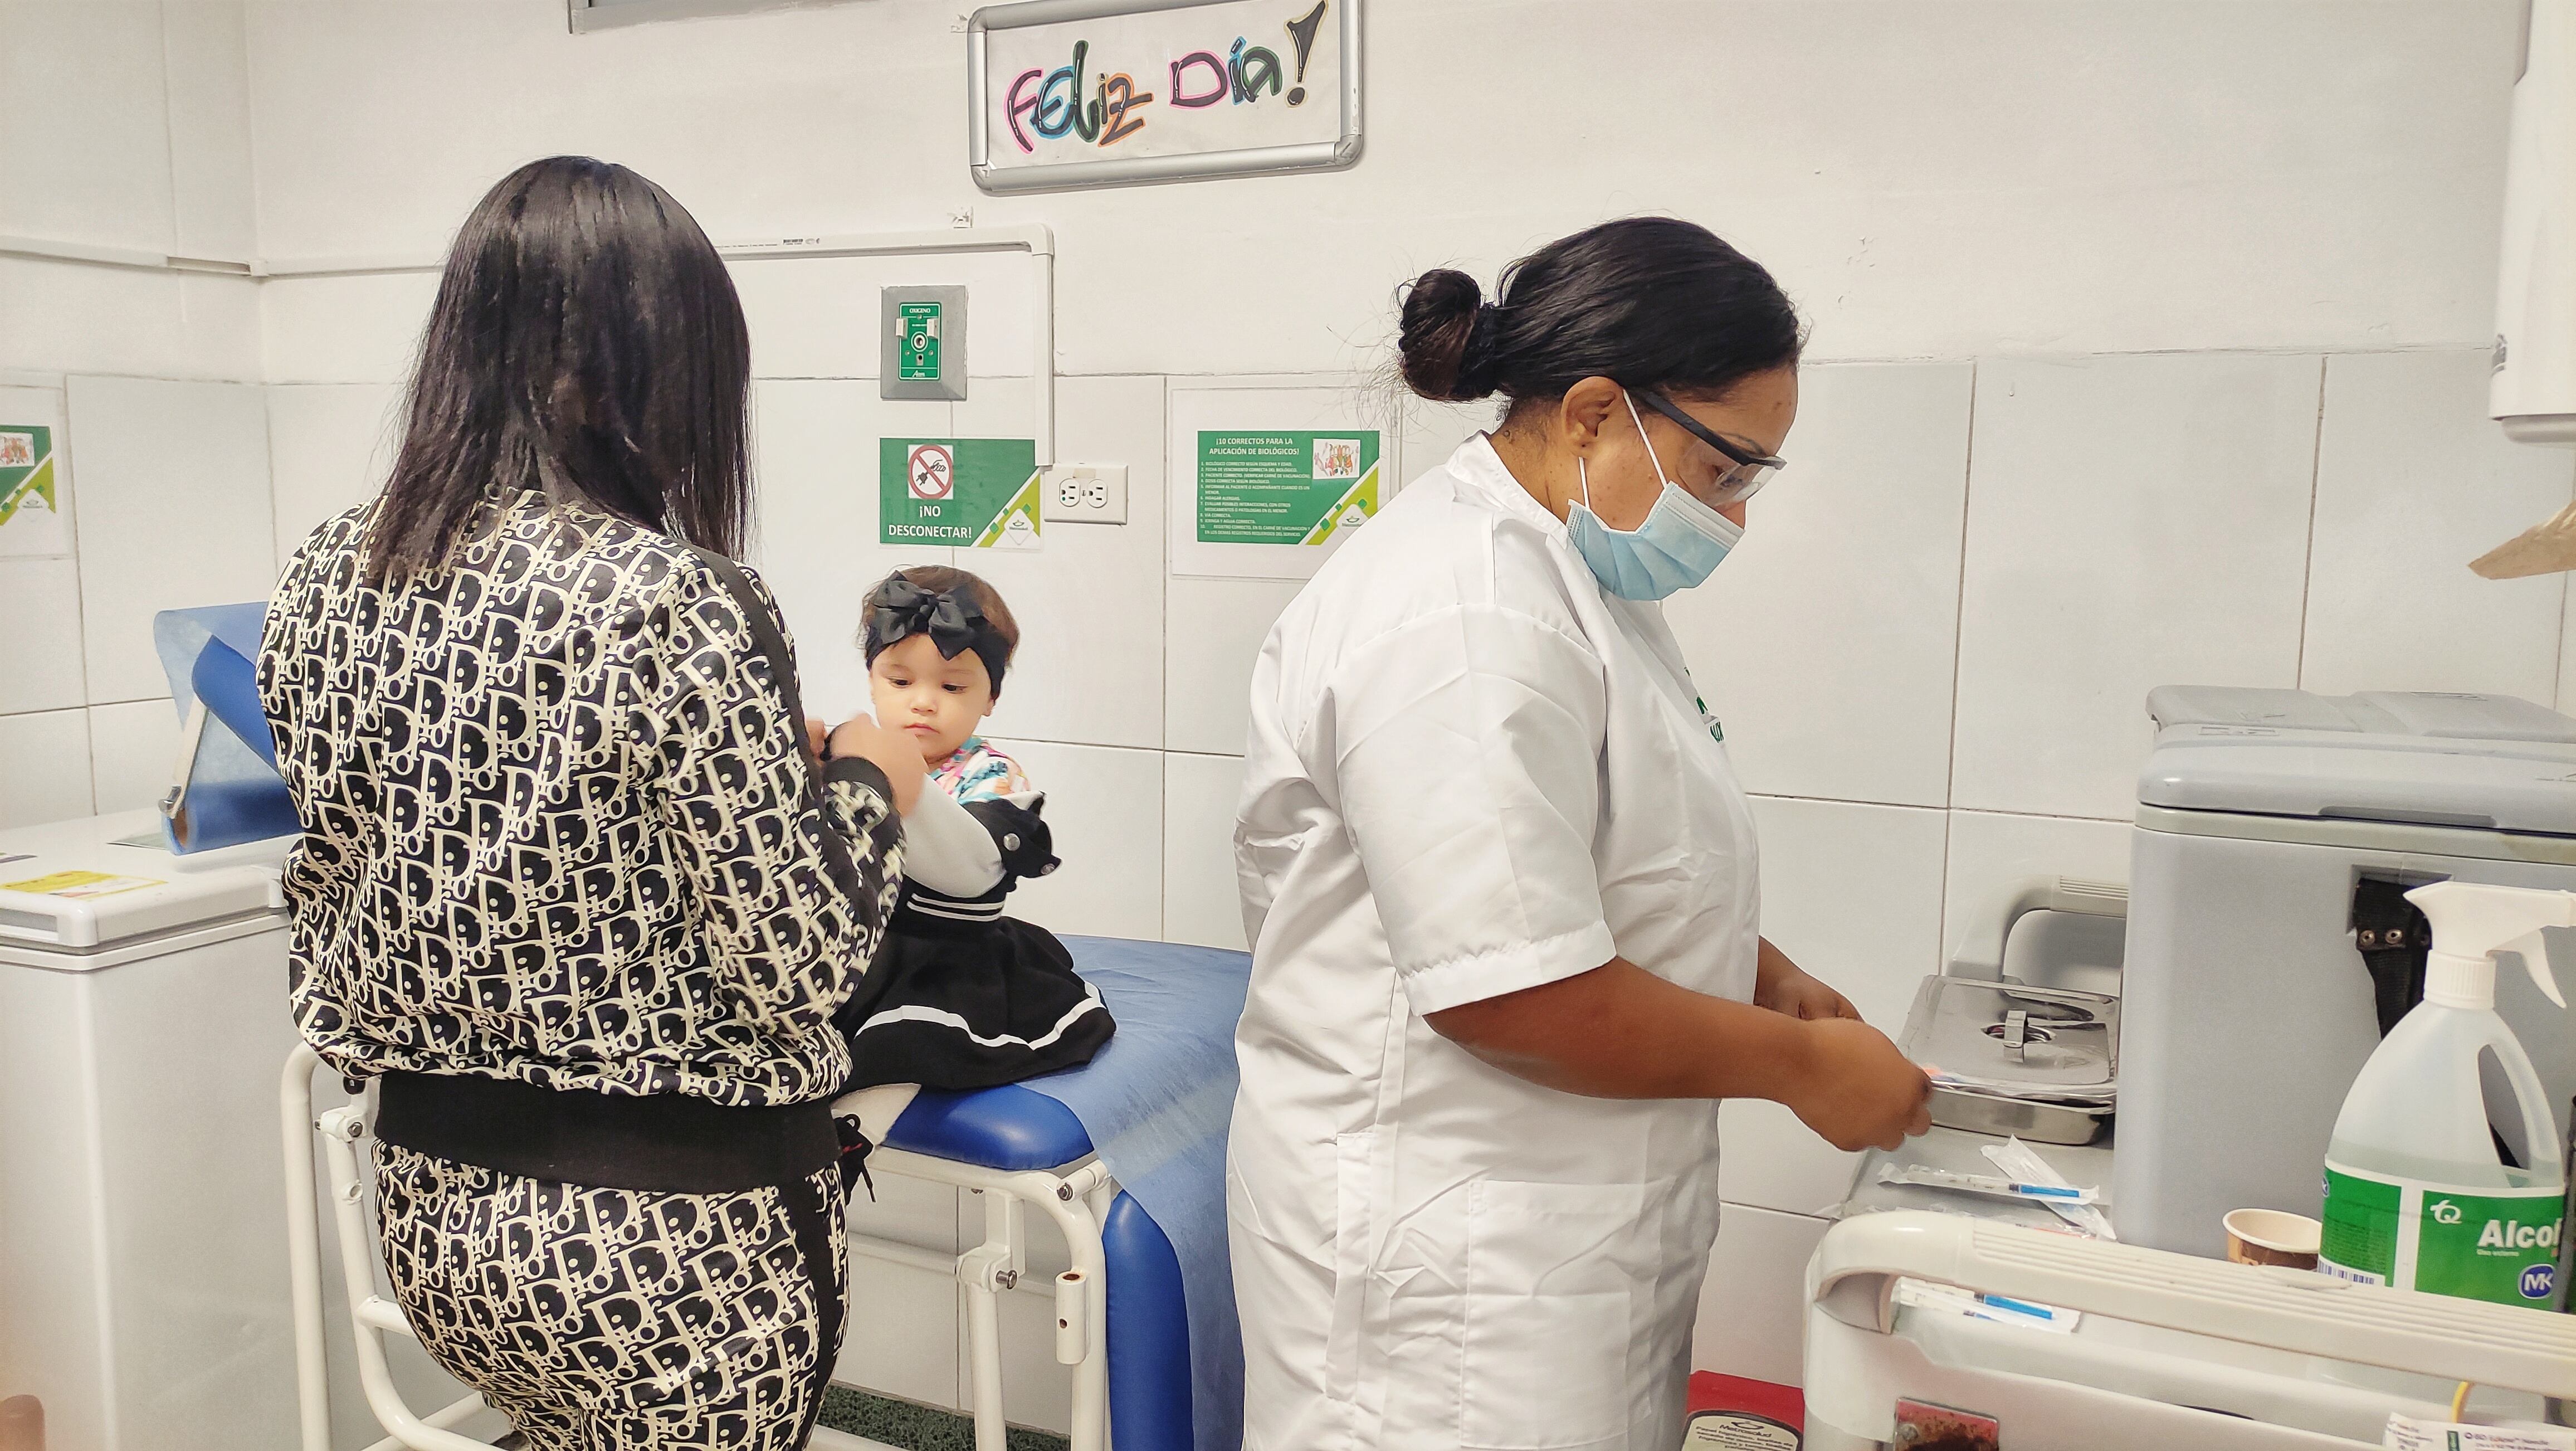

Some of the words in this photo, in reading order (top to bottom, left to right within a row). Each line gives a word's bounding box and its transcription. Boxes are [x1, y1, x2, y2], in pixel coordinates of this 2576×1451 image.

[1209, 446, 1247, 455] APLICACIÓN
[1258, 446, 1299, 455] BIOLÓGICOS!
[919, 505, 941, 518] ¡NO
[889, 524, 972, 538] DESCONECTAR!
[2524, 1273, 2554, 1291] MK
[1719, 1424, 1772, 1438] Metrosalud
